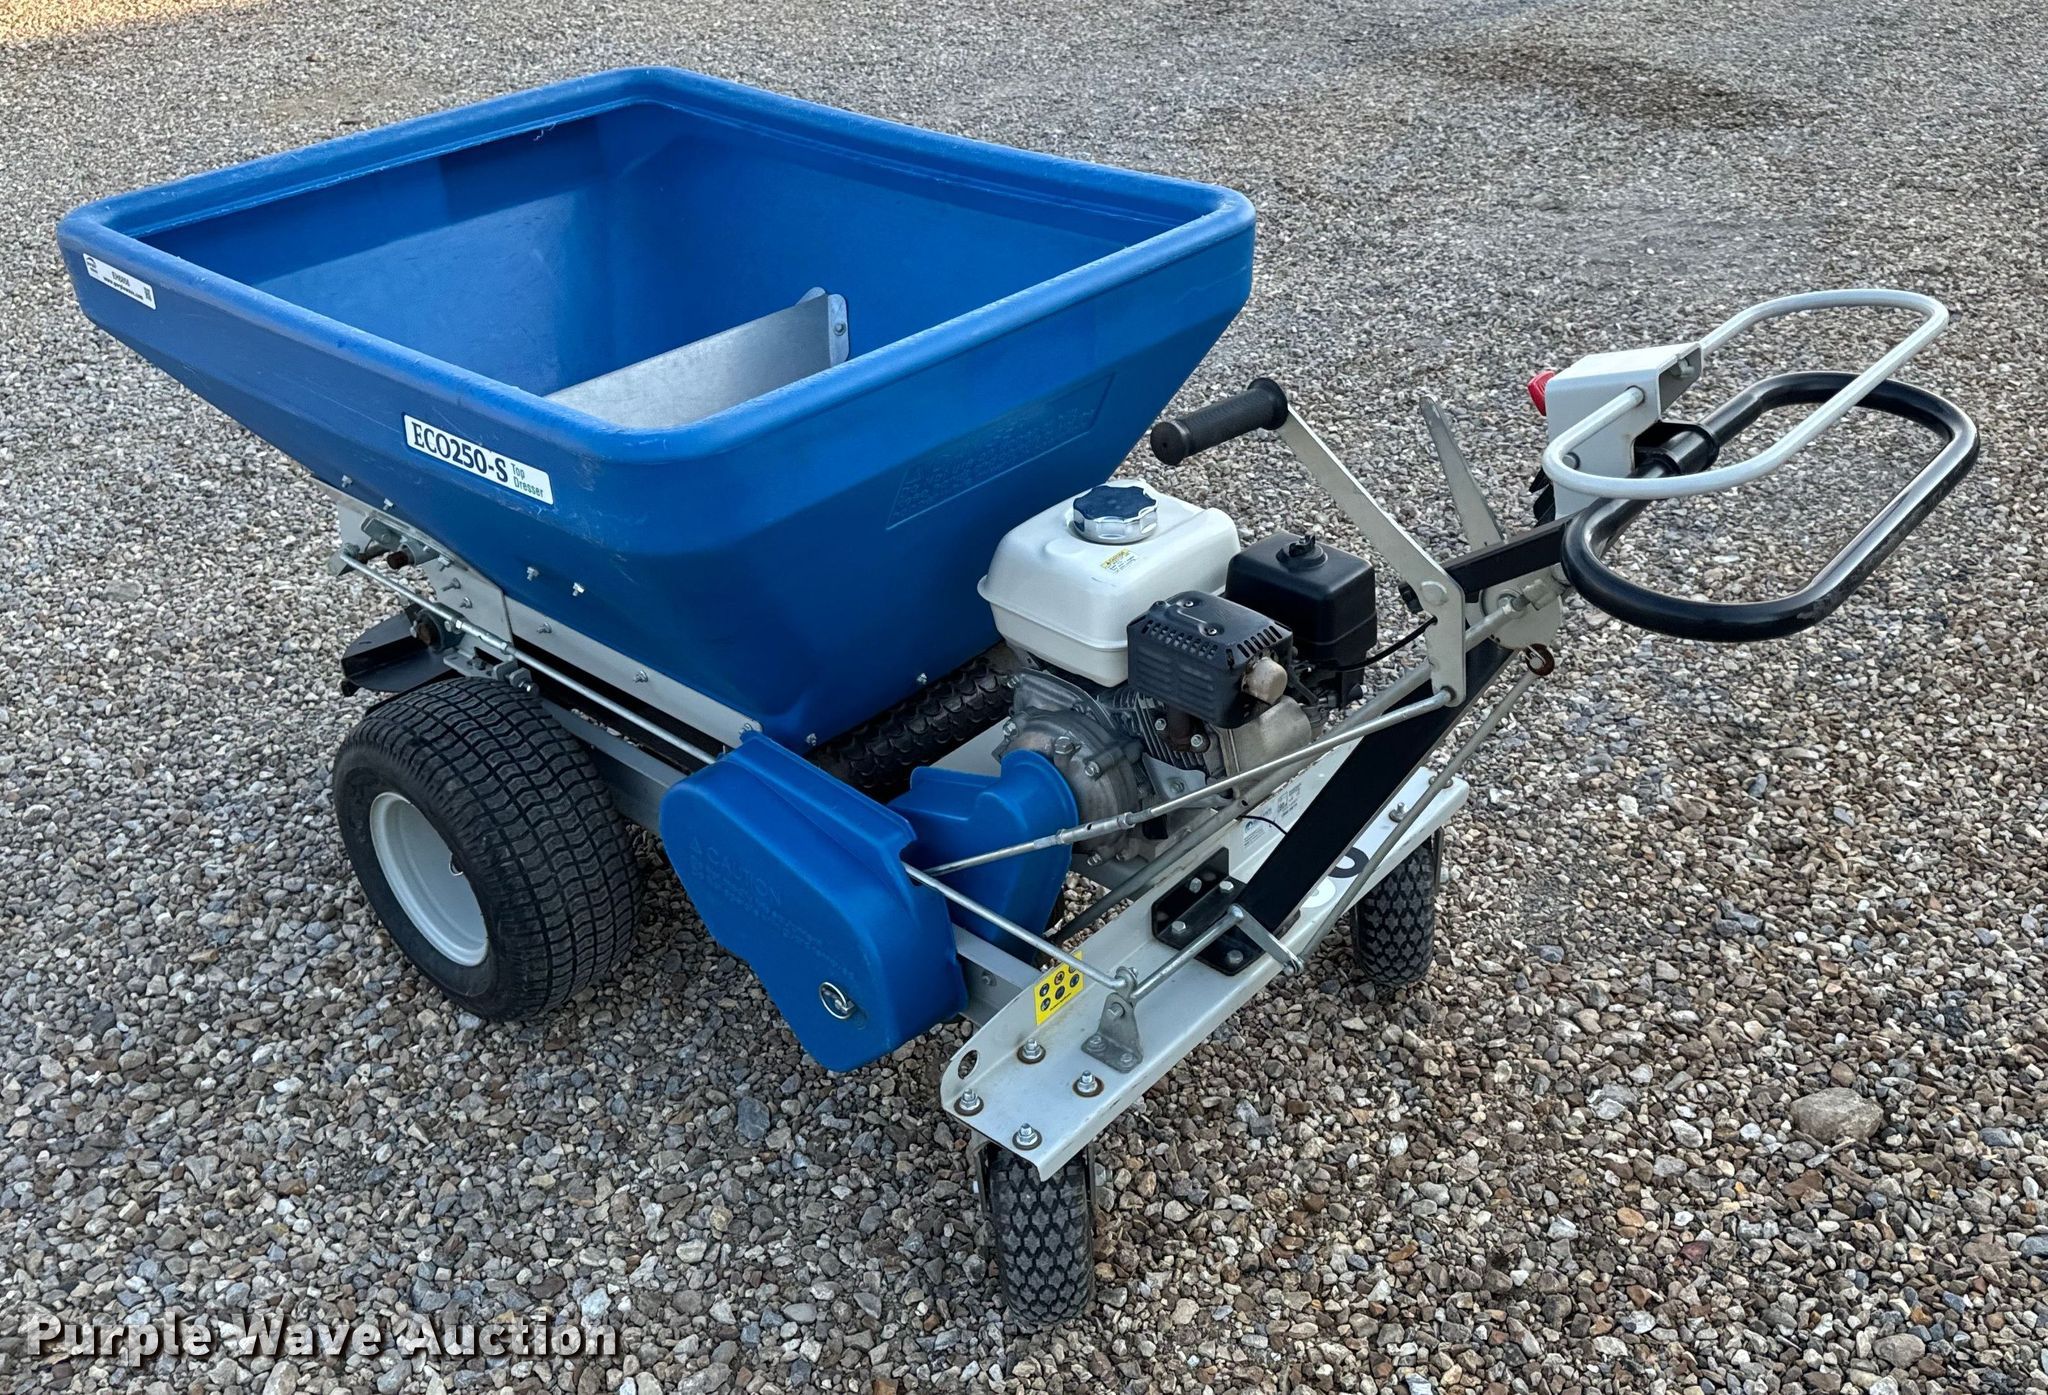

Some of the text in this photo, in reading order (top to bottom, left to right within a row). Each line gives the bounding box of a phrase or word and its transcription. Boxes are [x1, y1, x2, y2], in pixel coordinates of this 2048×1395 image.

[411, 422, 508, 483] ECO250-S
[511, 463, 525, 480] Top
[513, 476, 544, 498] Dresser
